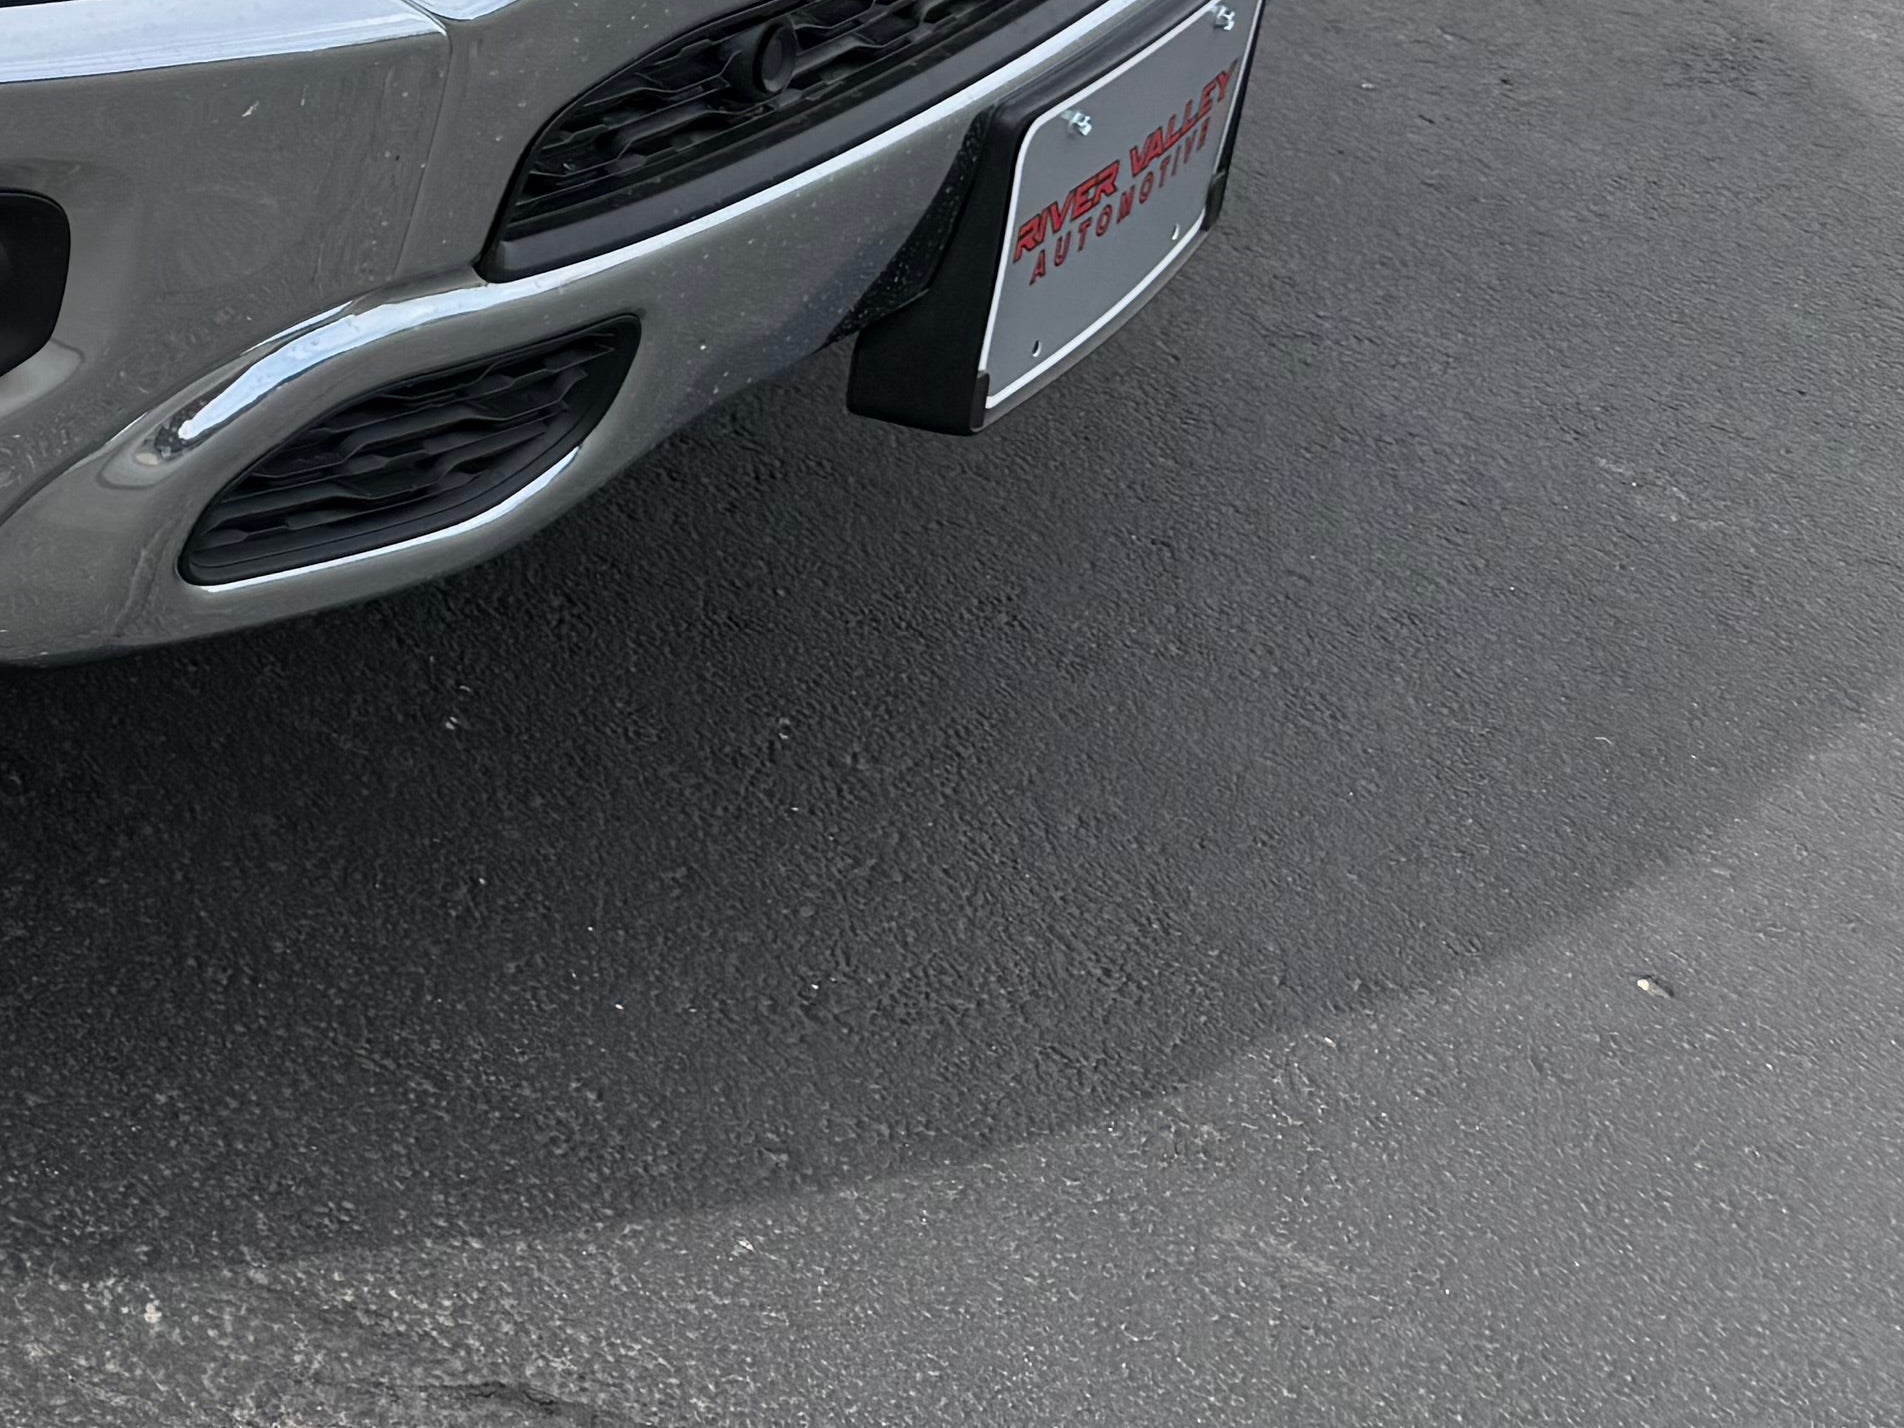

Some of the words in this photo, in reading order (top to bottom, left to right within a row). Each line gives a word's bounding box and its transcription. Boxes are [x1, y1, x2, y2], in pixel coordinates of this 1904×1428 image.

[1013, 159, 1121, 264] RIVER
[1129, 58, 1239, 178] VALLEY
[1028, 116, 1212, 286] AUTOMOTIVE
